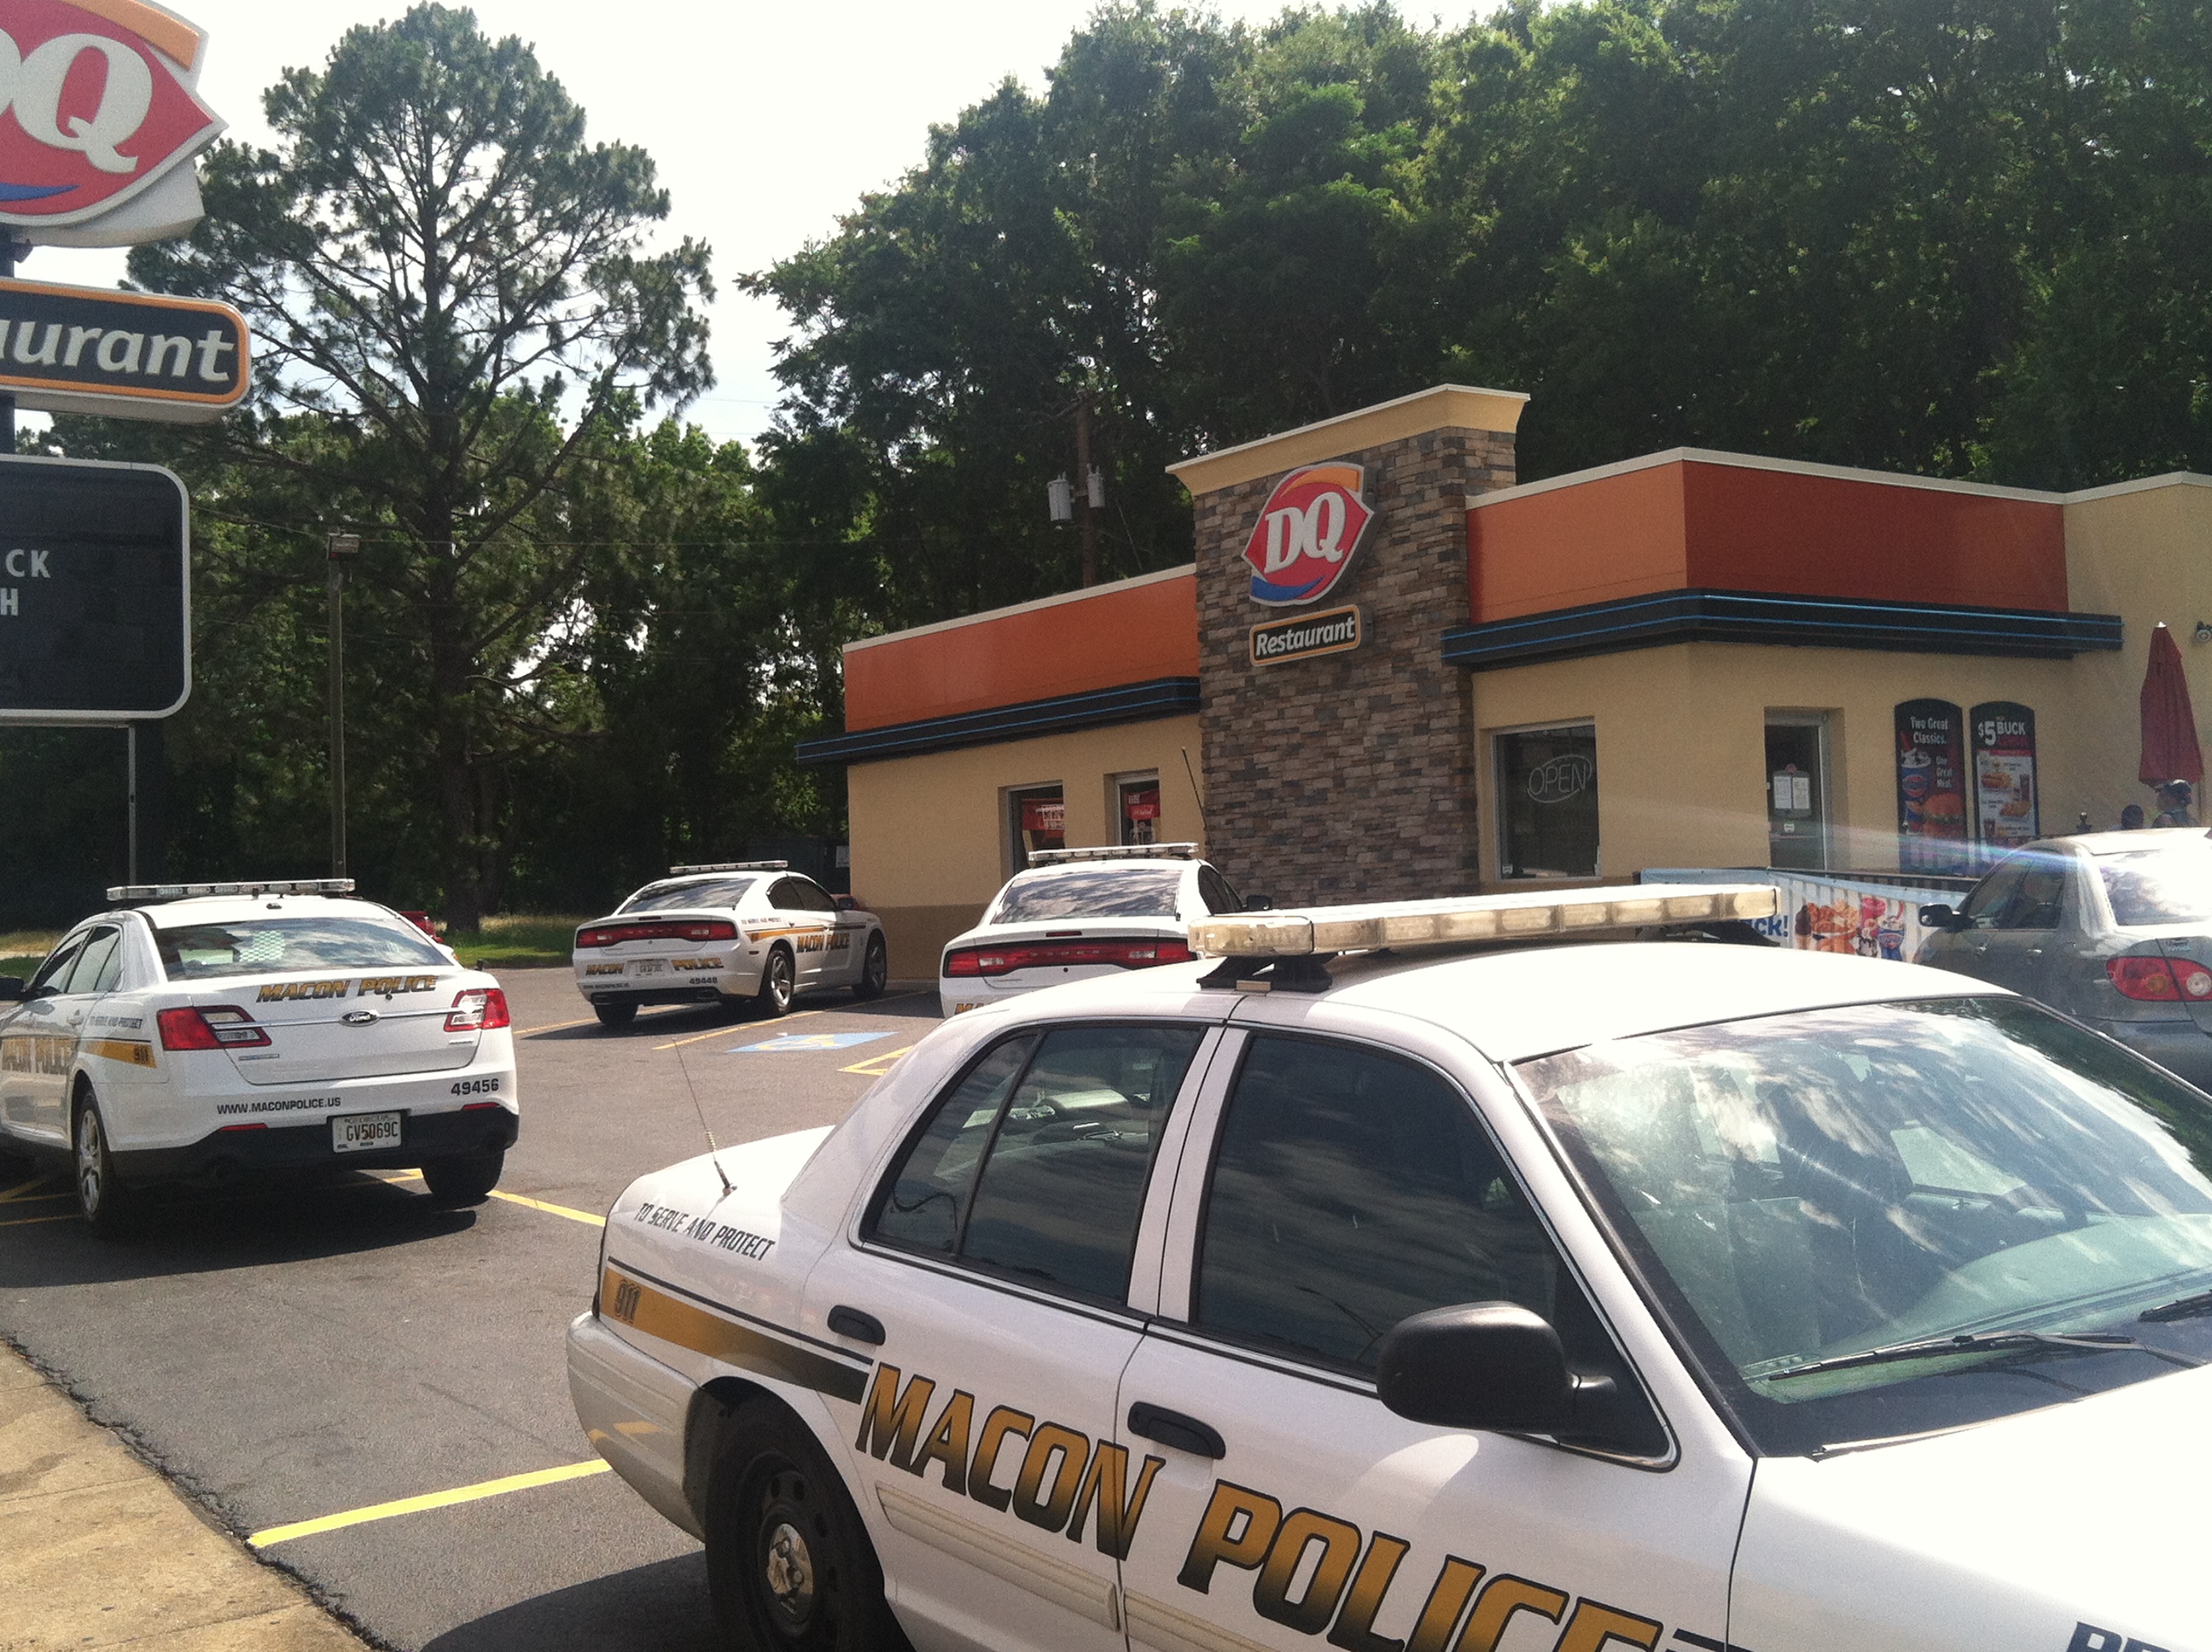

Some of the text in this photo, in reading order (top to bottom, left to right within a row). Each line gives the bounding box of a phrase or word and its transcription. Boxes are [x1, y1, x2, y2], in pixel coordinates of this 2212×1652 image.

[0, 319, 235, 382] urant
[1264, 491, 1347, 574] DQ
[1255, 616, 1355, 656] Restaurant
[1910, 716, 1948, 730] Two Great
[1978, 721, 1996, 746] $5
[1997, 721, 2026, 736] BUCK
[1528, 763, 1587, 795] OPEN
[1745, 916, 1789, 938] ck!
[672, 957, 724, 972] POLICE
[256, 974, 438, 1003] MACON POLICE
[451, 1078, 499, 1096] 49456
[217, 1097, 341, 1115] WWW.MACONPOLICE.US
[346, 1121, 399, 1142] GV5069C
[634, 1202, 776, 1261] TO SERVE AND PROTECT
[614, 1279, 642, 1324] 911
[855, 1361, 1166, 1562] MACON
